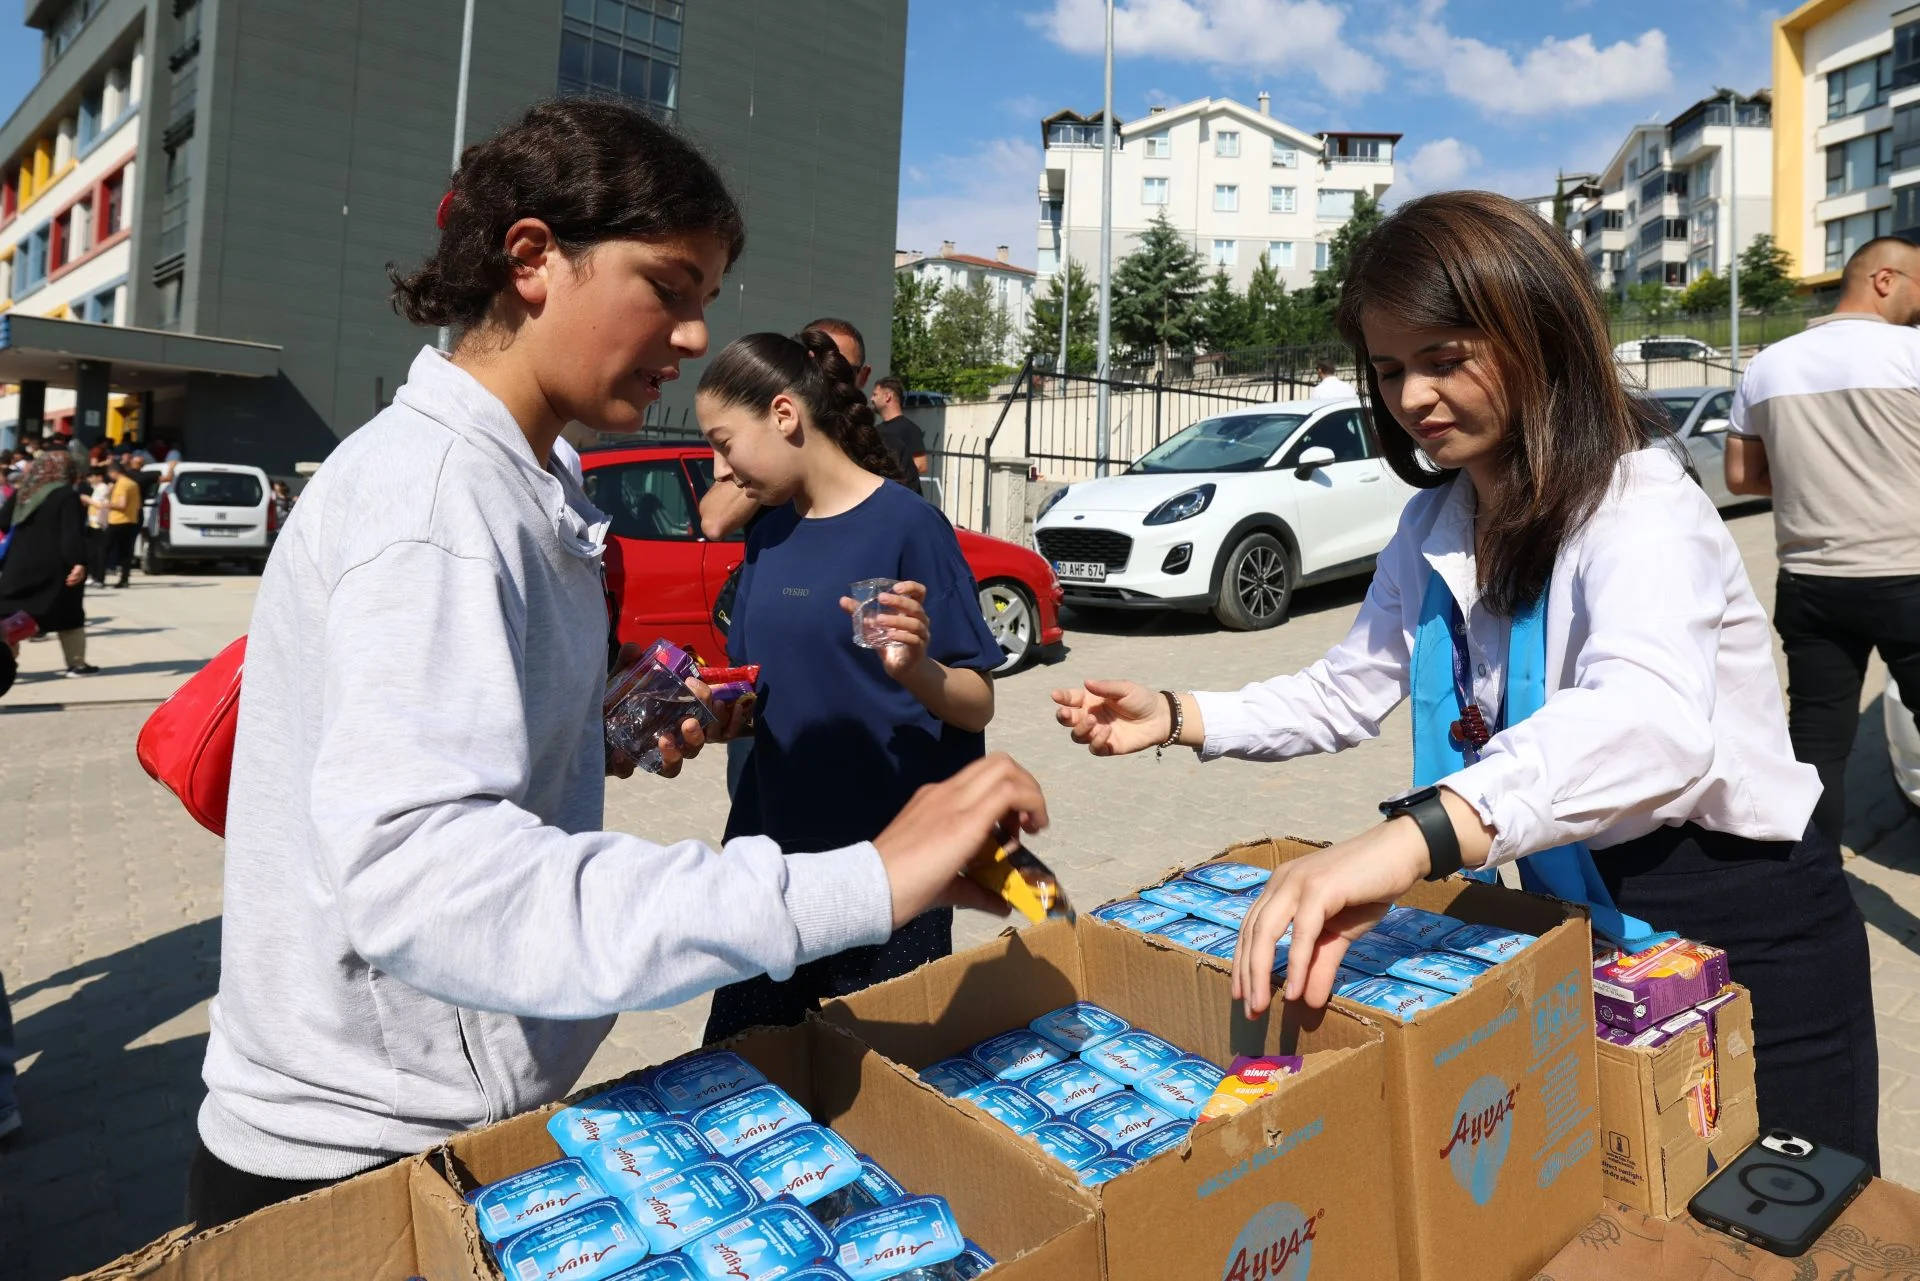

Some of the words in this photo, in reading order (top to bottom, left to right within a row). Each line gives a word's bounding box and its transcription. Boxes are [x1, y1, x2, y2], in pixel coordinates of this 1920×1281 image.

[1070, 563, 1084, 576] AHF
[1088, 564, 1103, 577] 674
[782, 587, 809, 597] OYSHO
